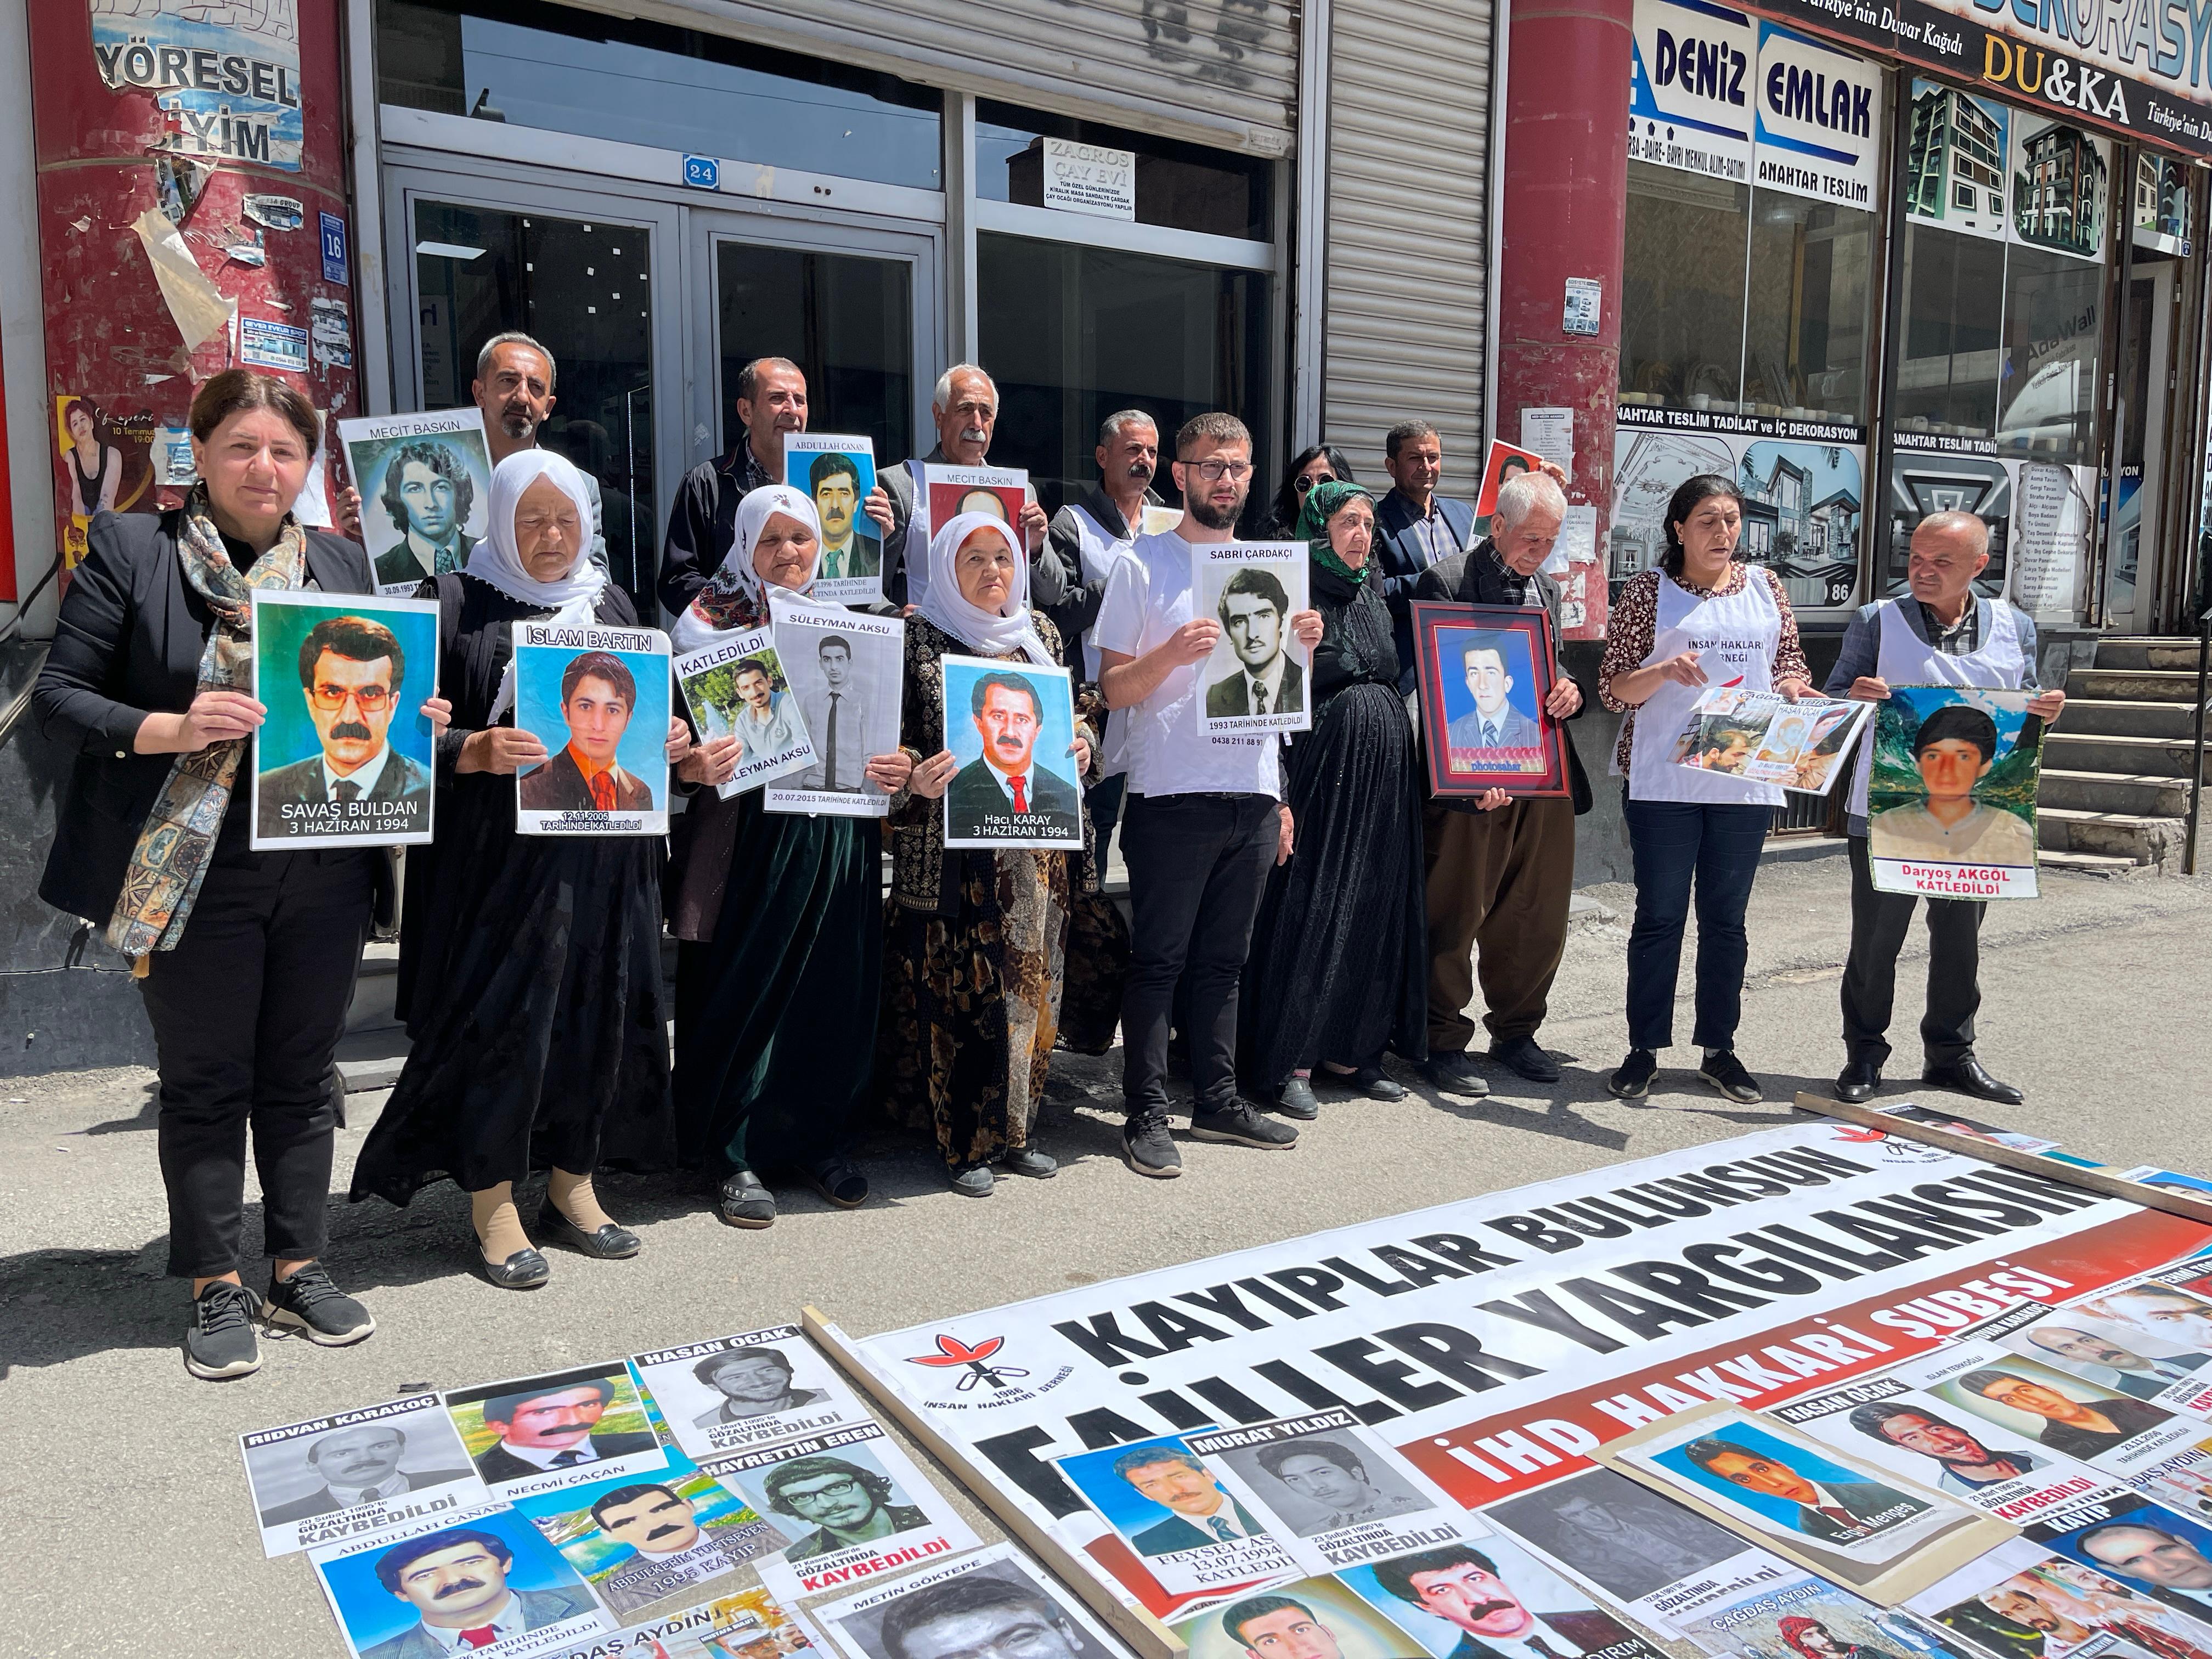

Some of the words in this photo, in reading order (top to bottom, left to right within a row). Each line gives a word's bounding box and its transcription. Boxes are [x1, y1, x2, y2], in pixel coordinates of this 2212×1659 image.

[1880, 7, 1921, 40] Duvar
[1922, 22, 1962, 55] Kağıdı
[95, 36, 298, 108] YÖRESEL
[1655, 28, 1747, 107] DENİZ
[1983, 33, 2130, 125] DU&KA
[2147, 101, 2199, 137] Türkiye'nin
[1767, 61, 1872, 139] EMLAK
[172, 99, 269, 162] İYİM
[1050, 141, 1129, 167] ZAGROS
[690, 165, 713, 181] 24
[1053, 162, 1091, 180] ÇAY
[1097, 170, 1126, 187] EVİ
[280, 200, 300, 208] GROUP
[1073, 198, 1113, 208] ORGANİZASYONU
[1085, 192, 1109, 201] SANDALYE
[327, 234, 341, 258] 16
[2028, 305, 2096, 360] AdaWall
[370, 424, 409, 439] MECİT
[414, 420, 460, 435] BASKIN
[1667, 411, 1709, 428] TESLİM
[1713, 415, 1758, 432] TADİLAT
[1760, 421, 1773, 433] ve
[1775, 417, 1787, 437] İÇ
[1789, 425, 1857, 441] DEKORASYON
[794, 441, 840, 450] ABDULLAH
[842, 442, 864, 451] CANAN
[1938, 437, 1971, 451] TESLİM
[947, 473, 977, 484] MECİT
[979, 476, 1013, 486] BASKIN
[1210, 548, 1243, 560] SABRİ
[1245, 549, 1293, 560] ÇARDAKÇI
[384, 583, 414, 595] 30.09.1993
[839, 588, 876, 596] KATLEDİLDİ
[1831, 584, 1849, 601] 86
[789, 613, 856, 630] SÜLEYMAN
[857, 623, 890, 634] AKSU
[526, 625, 583, 647] İSLAM
[588, 631, 652, 651] BARTIN
[1721, 641, 1764, 650] HAKLARI
[680, 633, 765, 675] KATLEDİLDİ
[1209, 721, 1228, 730] 1993
[1229, 719, 1268, 729] TARİHİNDE
[1268, 715, 1303, 726] KATLEDİLDİ
[1778, 706, 1803, 715] HASAN
[1803, 708, 1822, 717] OCAK
[1212, 737, 1229, 745] 0438
[781, 745, 811, 764] AKSU
[281, 803, 341, 820] SAVAŞ
[348, 800, 417, 817] BULDAN
[772, 793, 816, 803] 20.07.2015
[817, 795, 851, 805] TARİHİNDE
[851, 797, 887, 806] KATLEDİLDİ
[290, 822, 298, 833] 3
[304, 817, 370, 833] HAZİRAN
[376, 818, 409, 831] 1994
[540, 820, 590, 831] TARİHİNDE
[591, 821, 642, 831] KATLEDİLDİ
[973, 826, 980, 836] 3
[983, 823, 1036, 837] HAZİRAN
[1040, 826, 1069, 837] 1994
[985, 814, 1009, 825] Hacı
[1013, 815, 1051, 825] KARAY
[1902, 864, 1952, 881] Daryoş
[1956, 868, 2011, 882] AKGÖL
[1916, 879, 2000, 895] KATLEDİLDİ
[1051, 1232, 1521, 1368] KAYIPLAR
[1483, 1145, 1879, 1255] BULUNSUN
[1472, 1163, 2115, 1355] YARGILANSIN
[2002, 1302, 2052, 1333] KARAKOÇ
[645, 1340, 726, 1365] HASAN
[730, 1327, 792, 1347] OCAK
[1434, 1419, 1600, 1484] İHD
[1592, 1317, 1894, 1429] HAKKARİ
[1870, 1261, 2075, 1349] ŞUBESİ
[1948, 1354, 1984, 1373] TERKOĞLU
[923, 1401, 968, 1409] İNSAN
[977, 1392, 1036, 1409] HAKLARI
[1037, 1365, 1075, 1392] DERNEĞİ
[993, 1387, 1024, 1400] 1986
[1783, 1394, 1847, 1424] HASAN
[1849, 1378, 1904, 1405] OCAK
[249, 1419, 329, 1447] RIDVAN
[335, 1396, 436, 1426] KARAKOÇ
[709, 1419, 782, 1440] GÖZALTINDA
[710, 1410, 843, 1449] KAYBEDİLDİ
[720, 1421, 740, 1430] Mart
[1194, 1427, 1277, 1454] MURAT
[1279, 1412, 1352, 1438] YILDIZ
[702, 1438, 821, 1477] HAYRETTİN
[824, 1425, 882, 1448] EREN
[506, 1477, 563, 1497] NECMİ
[568, 1465, 625, 1485] ÇAÇAN
[1978, 1488, 1998, 1501] Mart
[1979, 1485, 2038, 1508] GÖZALTINDA
[1993, 1475, 2099, 1520] KAYBEDİLDİ
[298, 1507, 387, 1533] GÖZALTINDA
[299, 1493, 458, 1545] KAYBEDİLDİ
[314, 1511, 346, 1525] Şubat
[349, 1500, 387, 1514] 1995'te
[1869, 1501, 1917, 1530] Mengeş
[2043, 1504, 2112, 1533] KAYIP
[338, 1522, 441, 1556] ABDULLAH
[444, 1502, 507, 1526] CANAN
[1317, 1528, 1393, 1553] GÖZALTINDA
[1324, 1529, 1351, 1542] Şubat
[1352, 1522, 1385, 1536] 1995'te
[1156, 1541, 1246, 1566] FEYSEL
[1323, 1521, 1463, 1566] KAYBEDİLDİ
[608, 1550, 693, 1593] ABDULKERİM
[691, 1522, 769, 1561] YURTSEVEN
[651, 1566, 701, 1594] 1995
[703, 1543, 756, 1573] KAYIP
[795, 1549, 880, 1578] GÖZALTINDA
[802, 1536, 952, 1592] KAYBEDİLDİ
[804, 1556, 829, 1567] Kasım
[830, 1547, 861, 1561] 1980'de
[1190, 1544, 1283, 1572] 13.07.1994
[853, 1586, 905, 1610] METİN
[909, 1559, 981, 1589] GÖKTEPE
[1653, 1579, 1720, 1612] GÖZALTINDA
[1711, 1599, 1780, 1633] ÇAĞDAŞ
[1779, 1583, 1825, 1606] AYDIN
[503, 1621, 600, 1657] KATLEDİLDİ
[632, 1612, 714, 1646] AYDIN
[700, 1627, 731, 1643] MUSTAFA
[732, 1617, 754, 1633] BULUT
